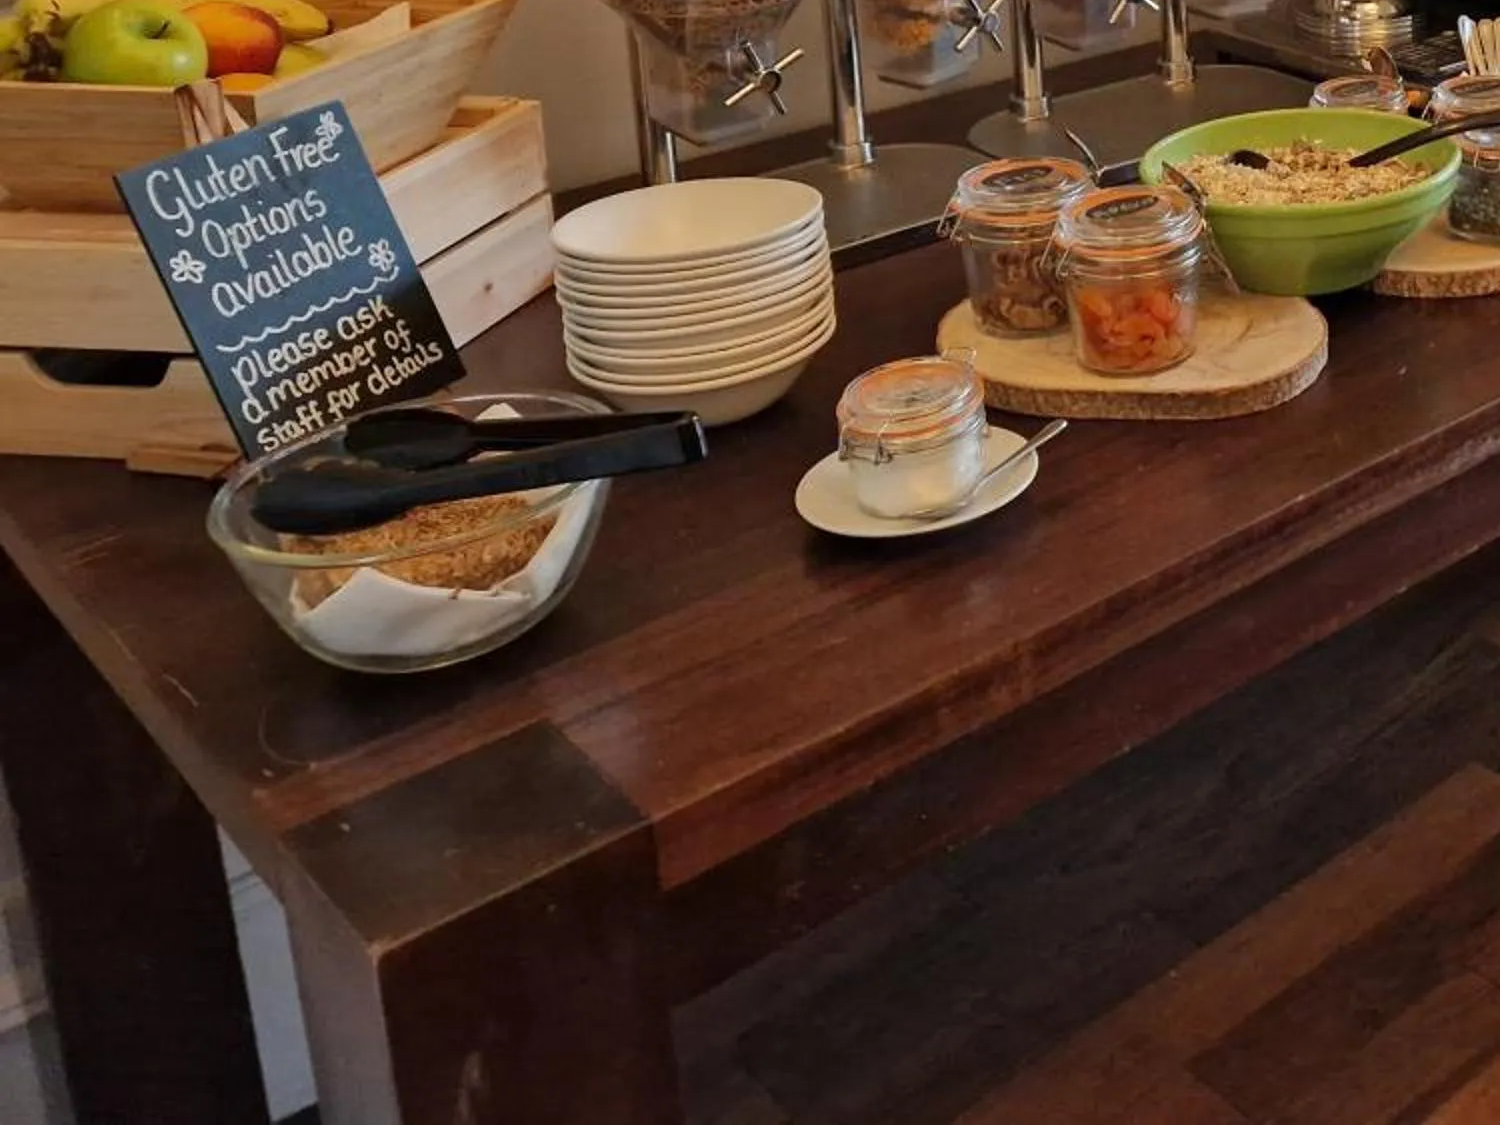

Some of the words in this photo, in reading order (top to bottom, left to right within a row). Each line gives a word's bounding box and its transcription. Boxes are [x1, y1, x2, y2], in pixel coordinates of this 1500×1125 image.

[145, 154, 276, 237] Gluten
[268, 126, 341, 176] Free
[201, 189, 328, 269] Options
[211, 225, 363, 318] available
[336, 295, 395, 341] ask
[241, 389, 271, 425] a
[265, 335, 378, 411] member
[384, 319, 412, 353] of
[326, 380, 362, 423] for
[367, 340, 444, 396] details
